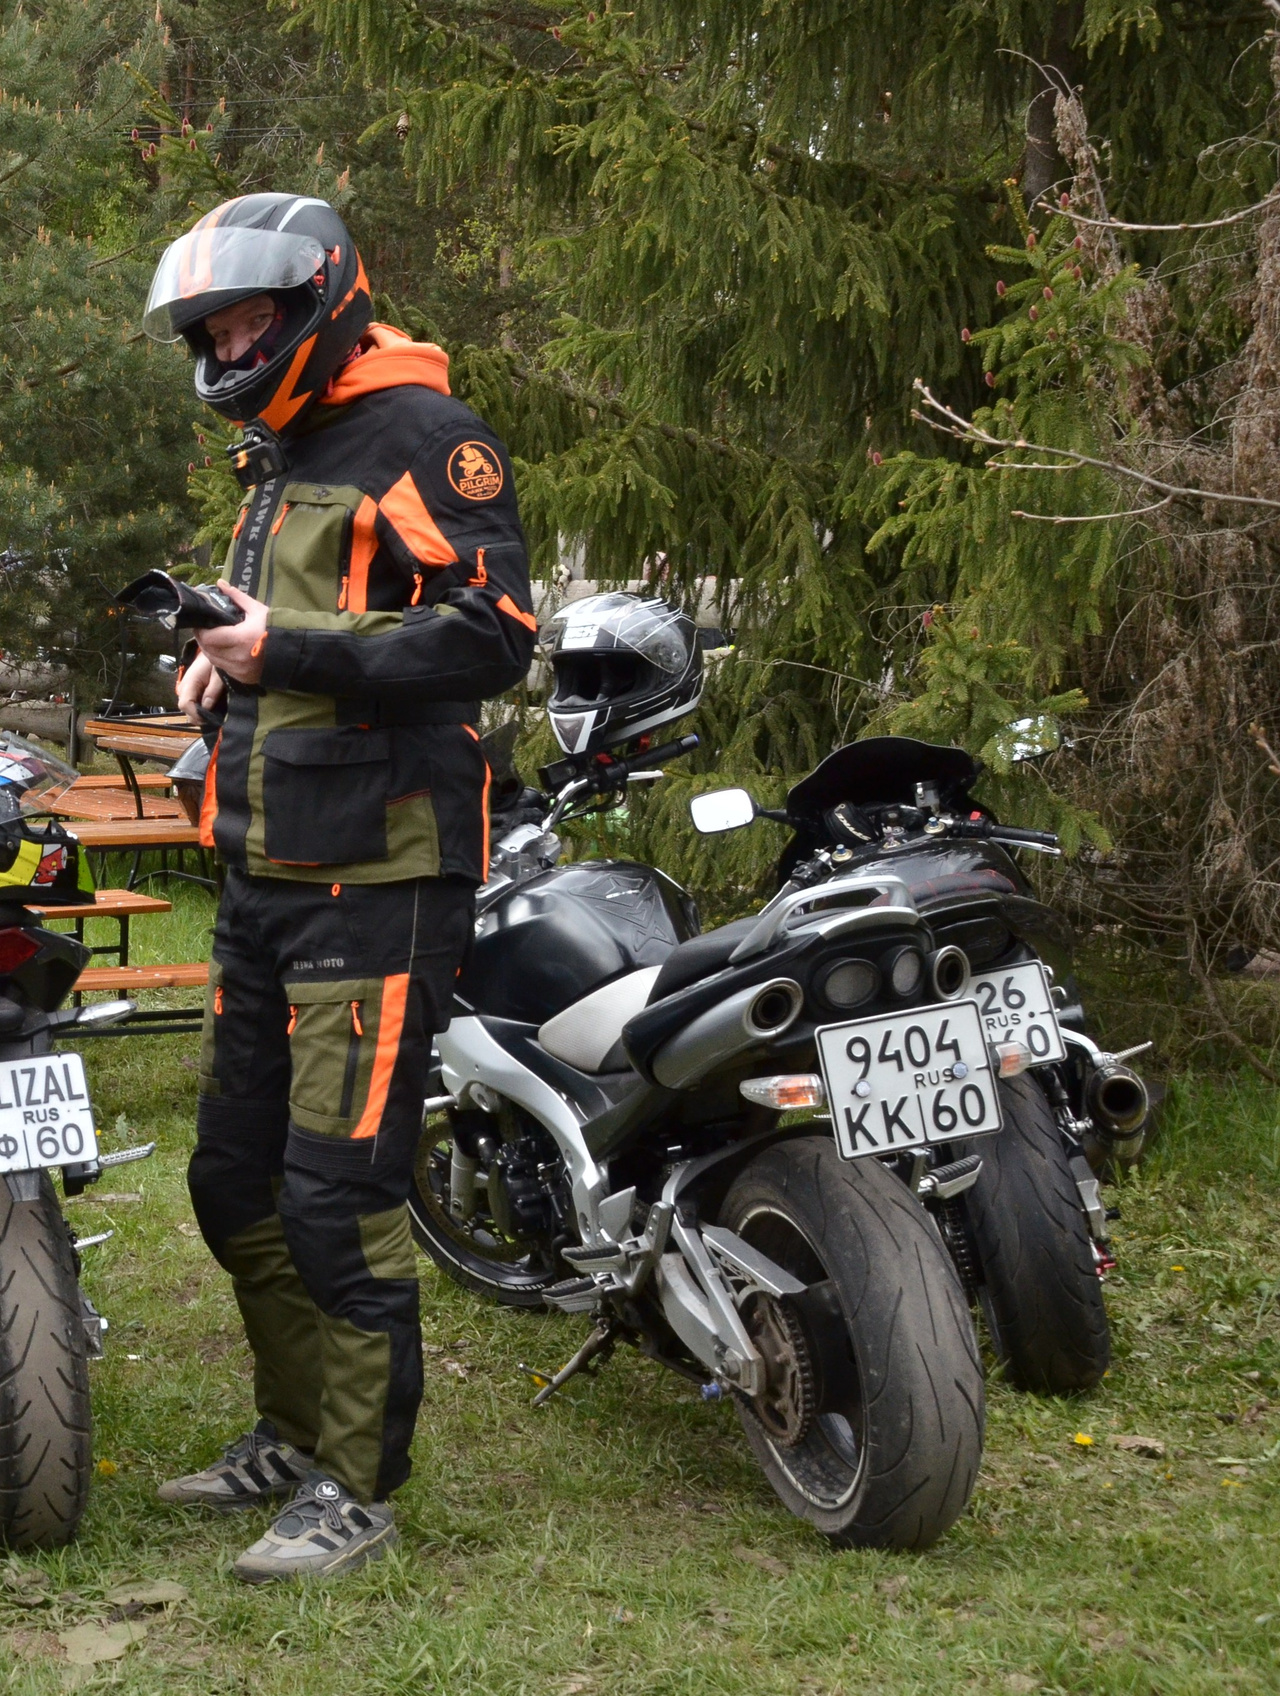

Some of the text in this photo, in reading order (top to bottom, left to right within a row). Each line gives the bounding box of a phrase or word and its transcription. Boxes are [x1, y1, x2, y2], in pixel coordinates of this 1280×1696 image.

[460, 476, 500, 491] PILGRIM
[238, 479, 277, 593] HAWK MOT
[975, 976, 1026, 1016] 26
[986, 1013, 1021, 1030] RUS
[846, 1018, 962, 1080] 9404
[914, 1068, 957, 1089] RUS
[23, 1108, 60, 1125] RUS
[932, 1083, 986, 1132] 60
[36, 1123, 84, 1159] 60
